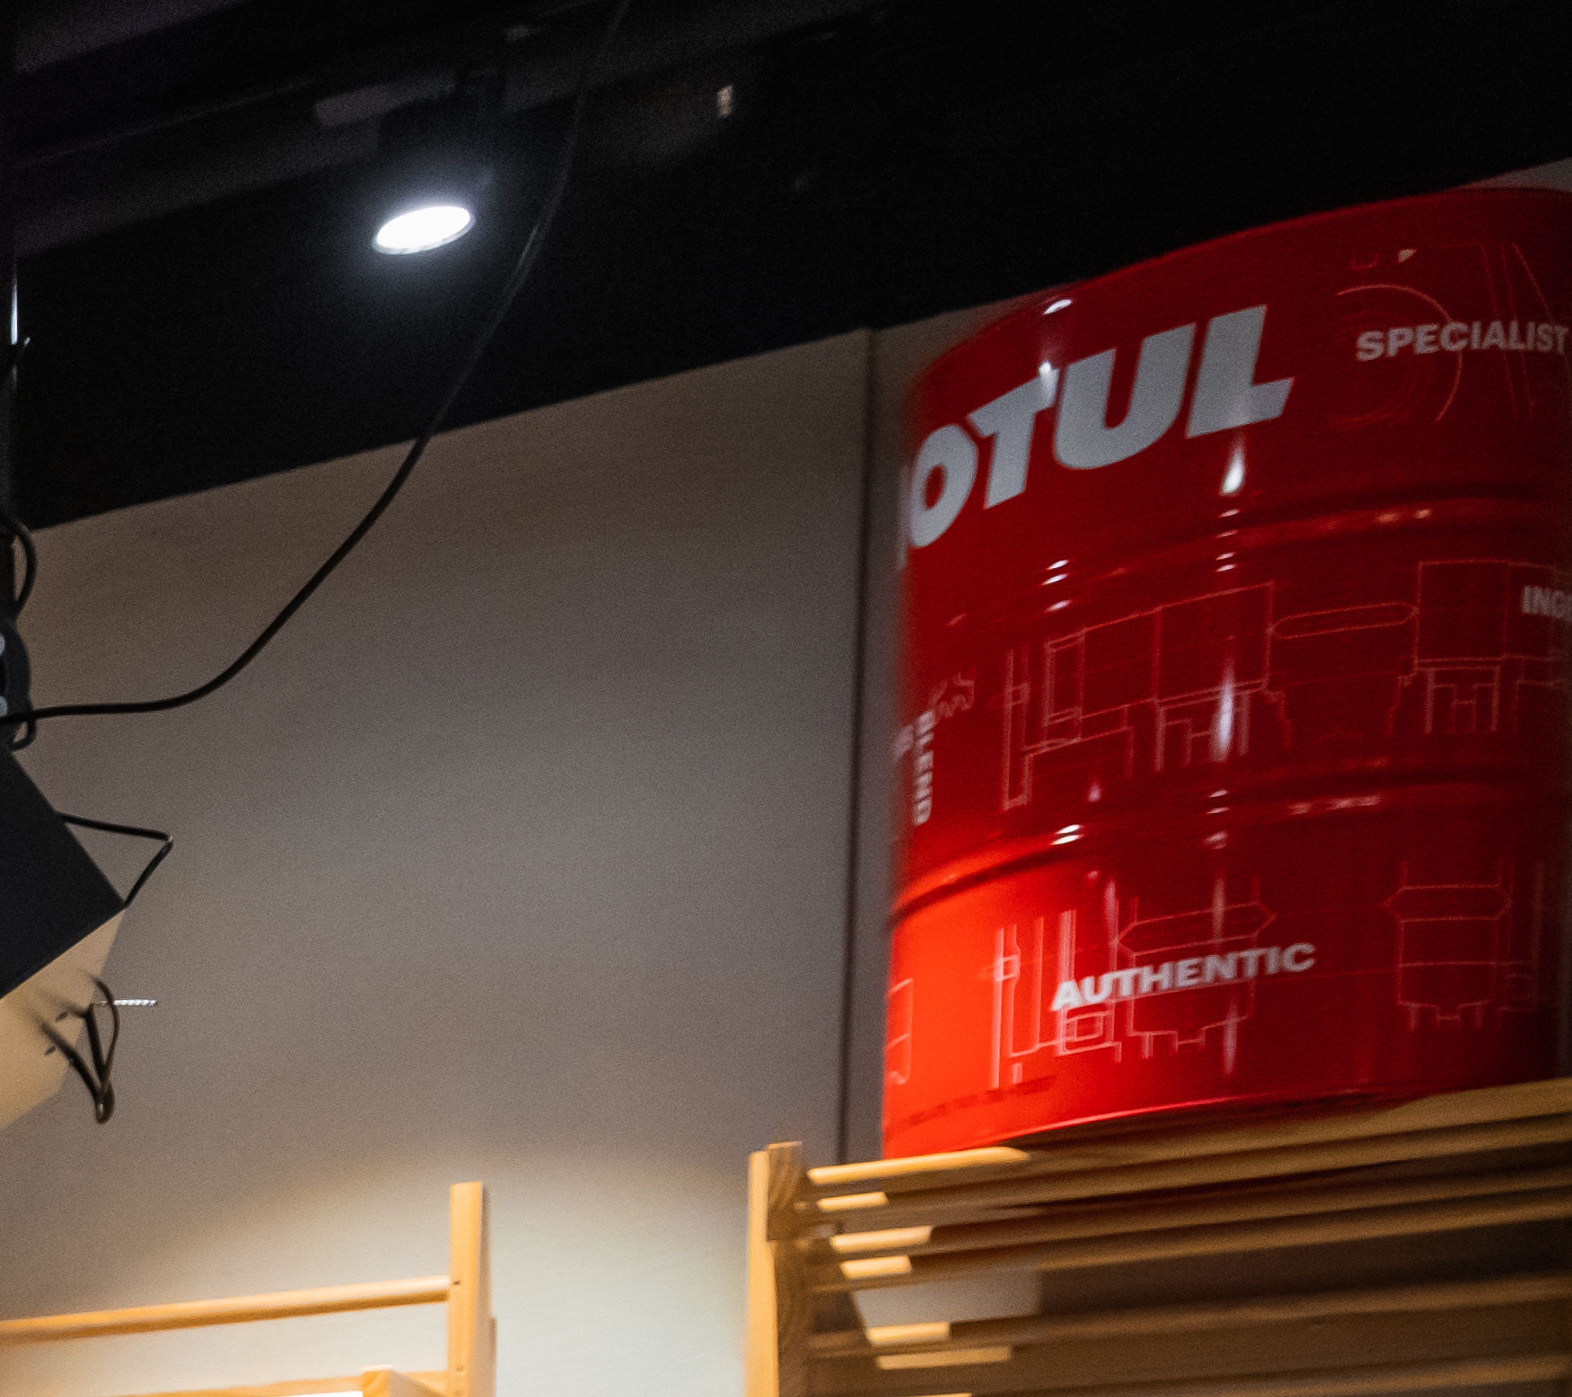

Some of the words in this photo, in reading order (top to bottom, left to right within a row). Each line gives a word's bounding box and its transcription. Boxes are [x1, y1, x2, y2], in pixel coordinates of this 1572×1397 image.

[1355, 319, 1570, 362] SPECIALIST
[908, 304, 1295, 549] OTUL
[1050, 942, 1317, 1011] AUTHENTIC
